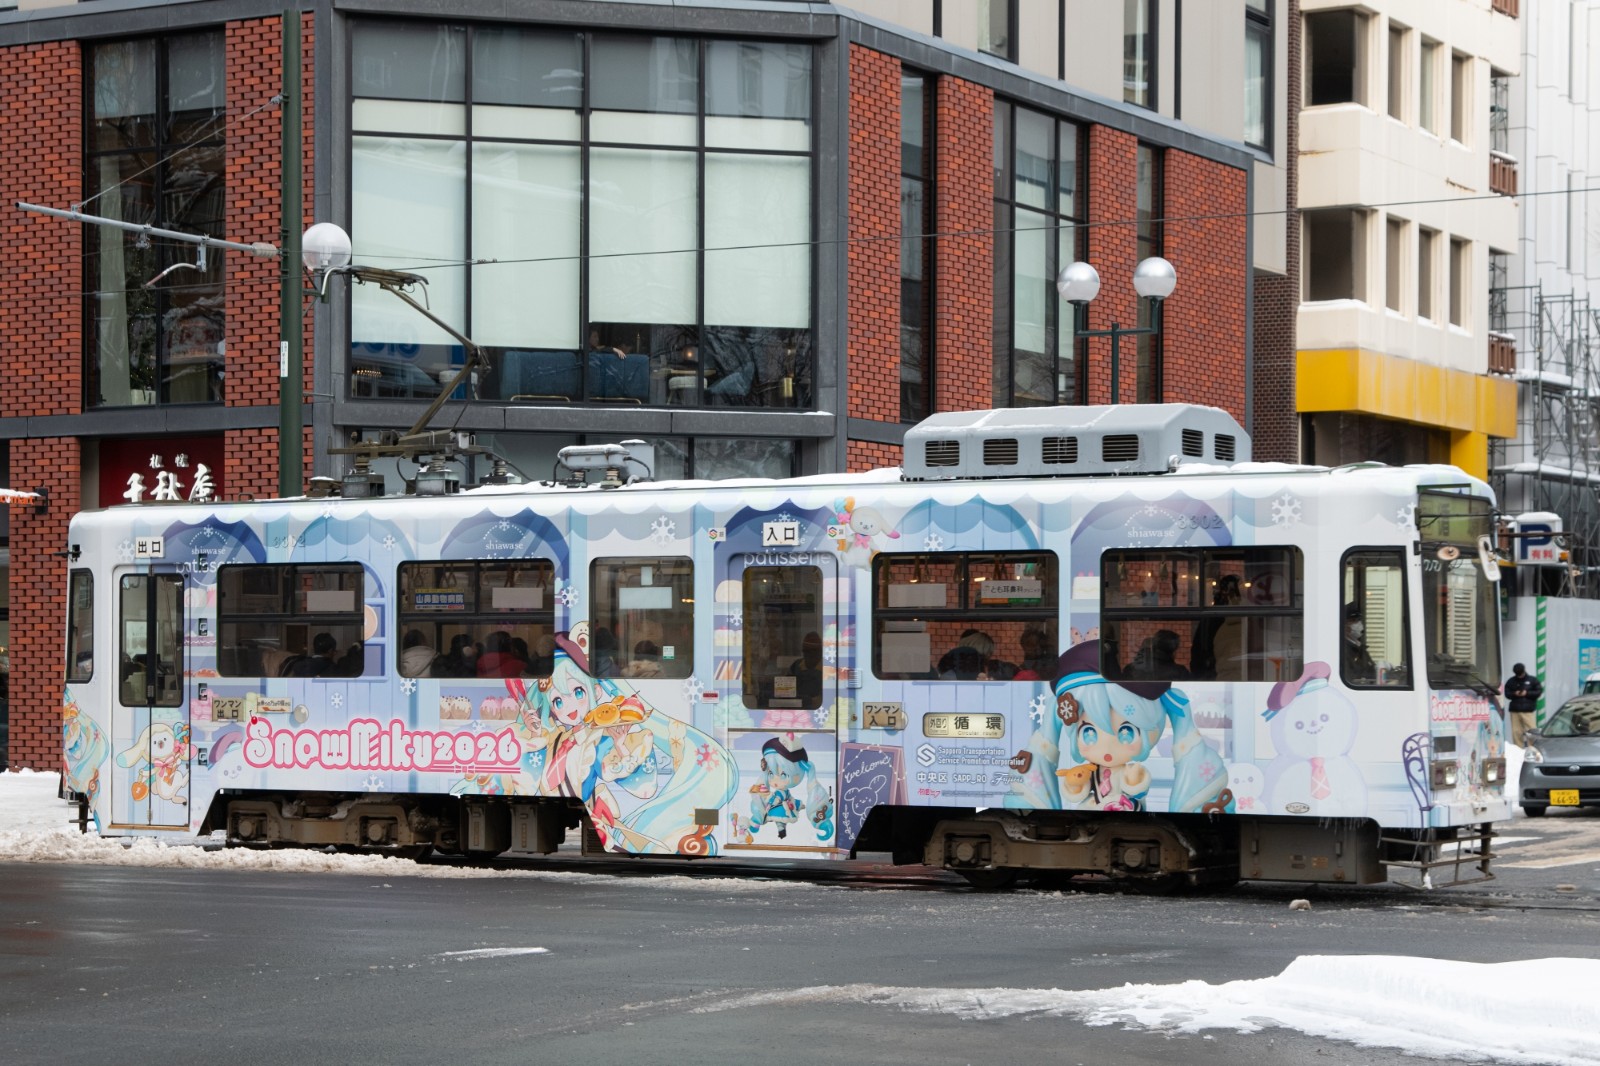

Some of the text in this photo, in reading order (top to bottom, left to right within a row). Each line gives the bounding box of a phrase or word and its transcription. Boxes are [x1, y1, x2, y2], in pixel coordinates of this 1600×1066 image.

[1177, 515, 1222, 530] 3302
[766, 527, 795, 542] 入口
[1127, 527, 1175, 538] shiawase
[138, 540, 161, 554] 出口
[485, 540, 524, 550] shiawase
[1520, 524, 1553, 560] P
[191, 545, 226, 555] shiawase
[1531, 549, 1553, 560] 有料
[743, 547, 831, 568] patisserie
[214, 700, 242, 708] ワンマン
[217, 709, 239, 719] 出口
[865, 705, 900, 715] ワンマン
[869, 716, 897, 727] 入口
[954, 716, 1002, 730] 循環
[939, 747, 1005, 756] Sapporo Transportation
[938, 757, 960, 765] Service
[991, 758, 1025, 767] Corporation
[844, 756, 892, 784] welcome
[917, 772, 947, 782] 中央区
